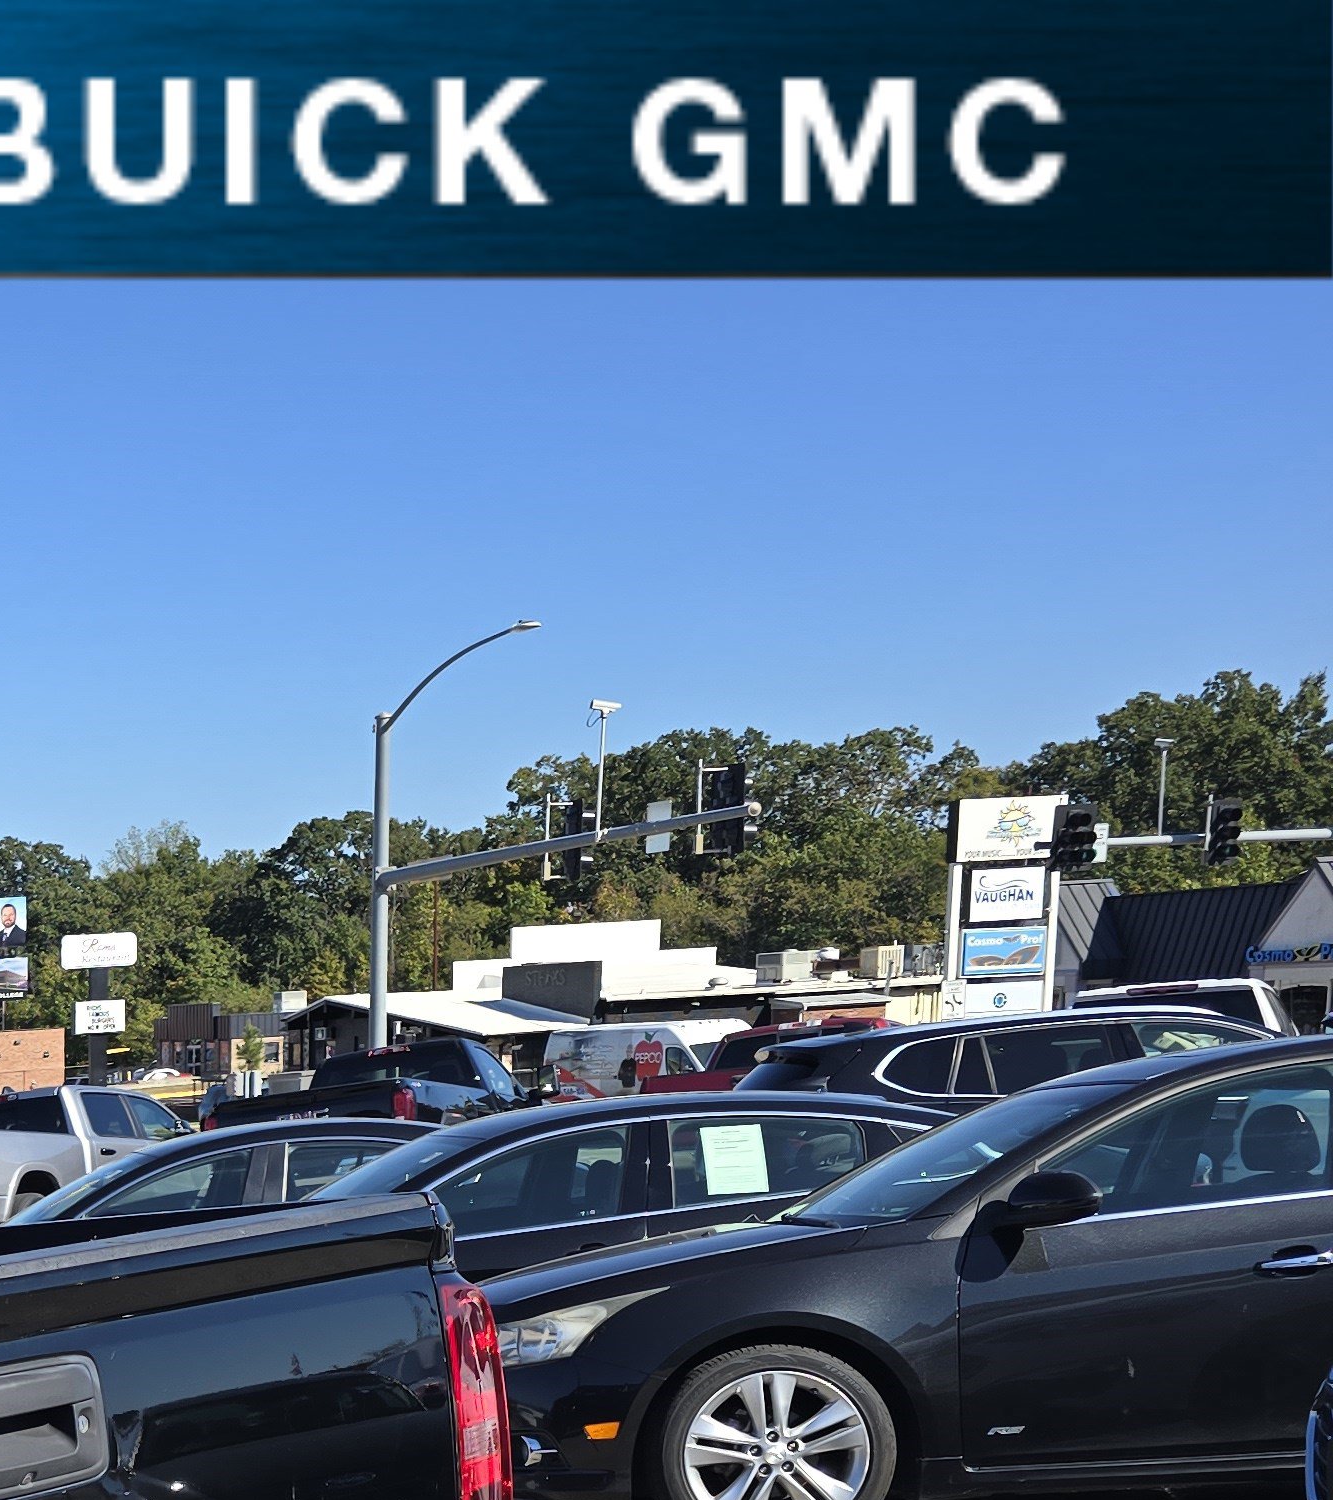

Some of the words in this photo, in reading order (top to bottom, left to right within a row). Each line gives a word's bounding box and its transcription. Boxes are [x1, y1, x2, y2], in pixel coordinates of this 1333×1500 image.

[974, 888, 1034, 904] VAUGHAN
[966, 935, 1004, 947] Cosmo
[1245, 945, 1294, 963] Cosmo
